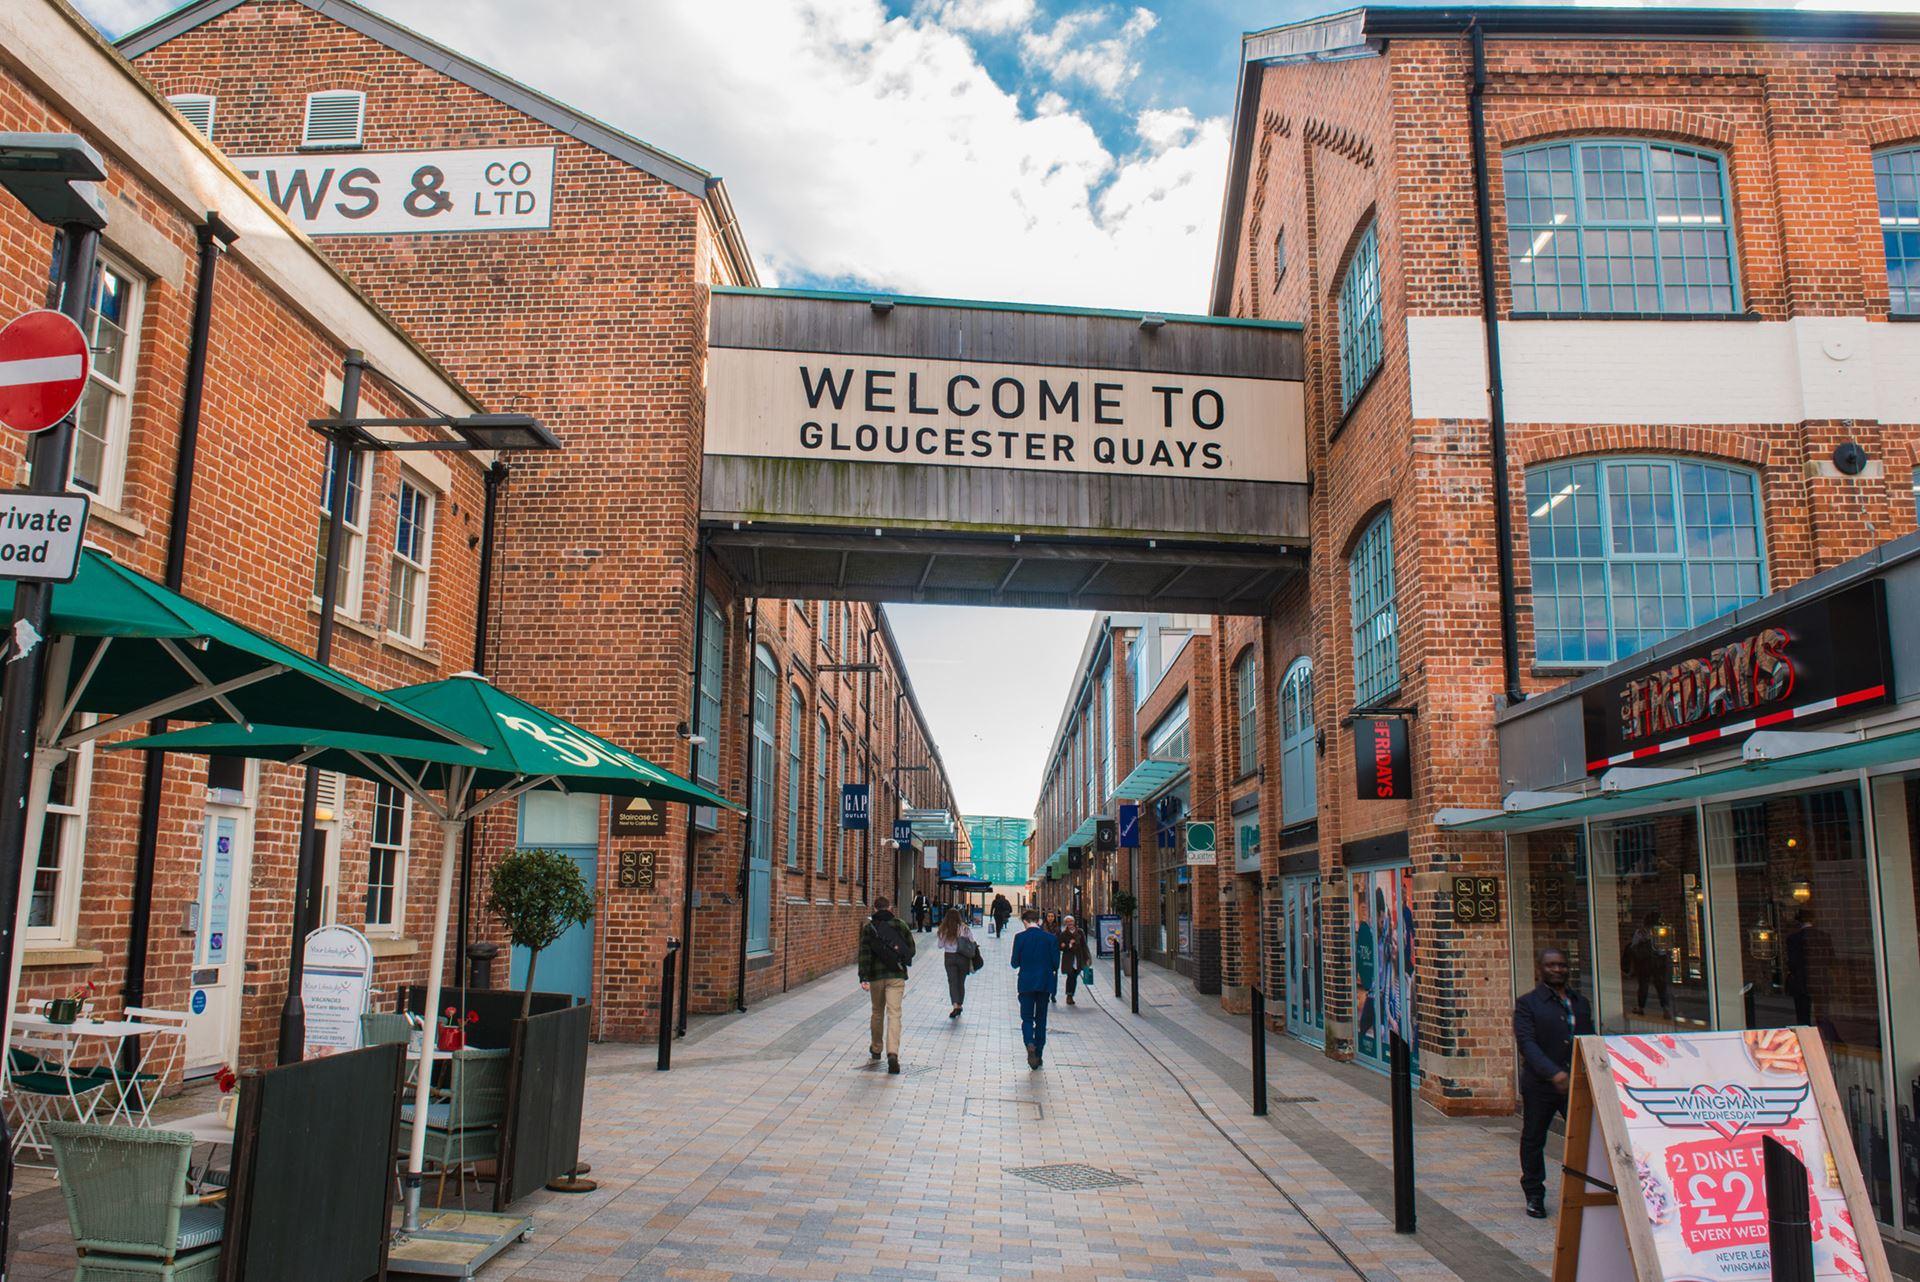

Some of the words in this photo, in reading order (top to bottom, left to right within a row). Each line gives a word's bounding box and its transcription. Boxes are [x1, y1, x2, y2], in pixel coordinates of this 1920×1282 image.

[485, 161, 531, 186] CO
[242, 167, 381, 221] WS
[403, 165, 454, 218] &
[474, 190, 536, 216] LTD
[799, 366, 1124, 425] WELCOME
[1152, 385, 1225, 430] TO
[800, 421, 1074, 462] GLOUCESTER
[1093, 436, 1223, 469] QUAYS
[0, 506, 72, 533] rivate
[0, 540, 49, 563] oad
[1630, 627, 1796, 738] FRIDAYS
[1374, 728, 1393, 797] FRIDAYS
[845, 794, 868, 812] GAP
[619, 813, 651, 821] Staircase
[652, 813, 659, 821] C
[894, 826, 910, 839] GAP
[1675, 1095, 1765, 1110] WINGMAN
[1690, 1110, 1757, 1120] WEDNESDAY
[1672, 1154, 1688, 1173] 2
[1692, 1149, 1748, 1171] DINE
[1688, 1170, 1767, 1225] £2
[1690, 1226, 1732, 1243] EVERY
[1716, 1250, 1749, 1262] NEVER
[1720, 1261, 1770, 1273] WINGMAN
